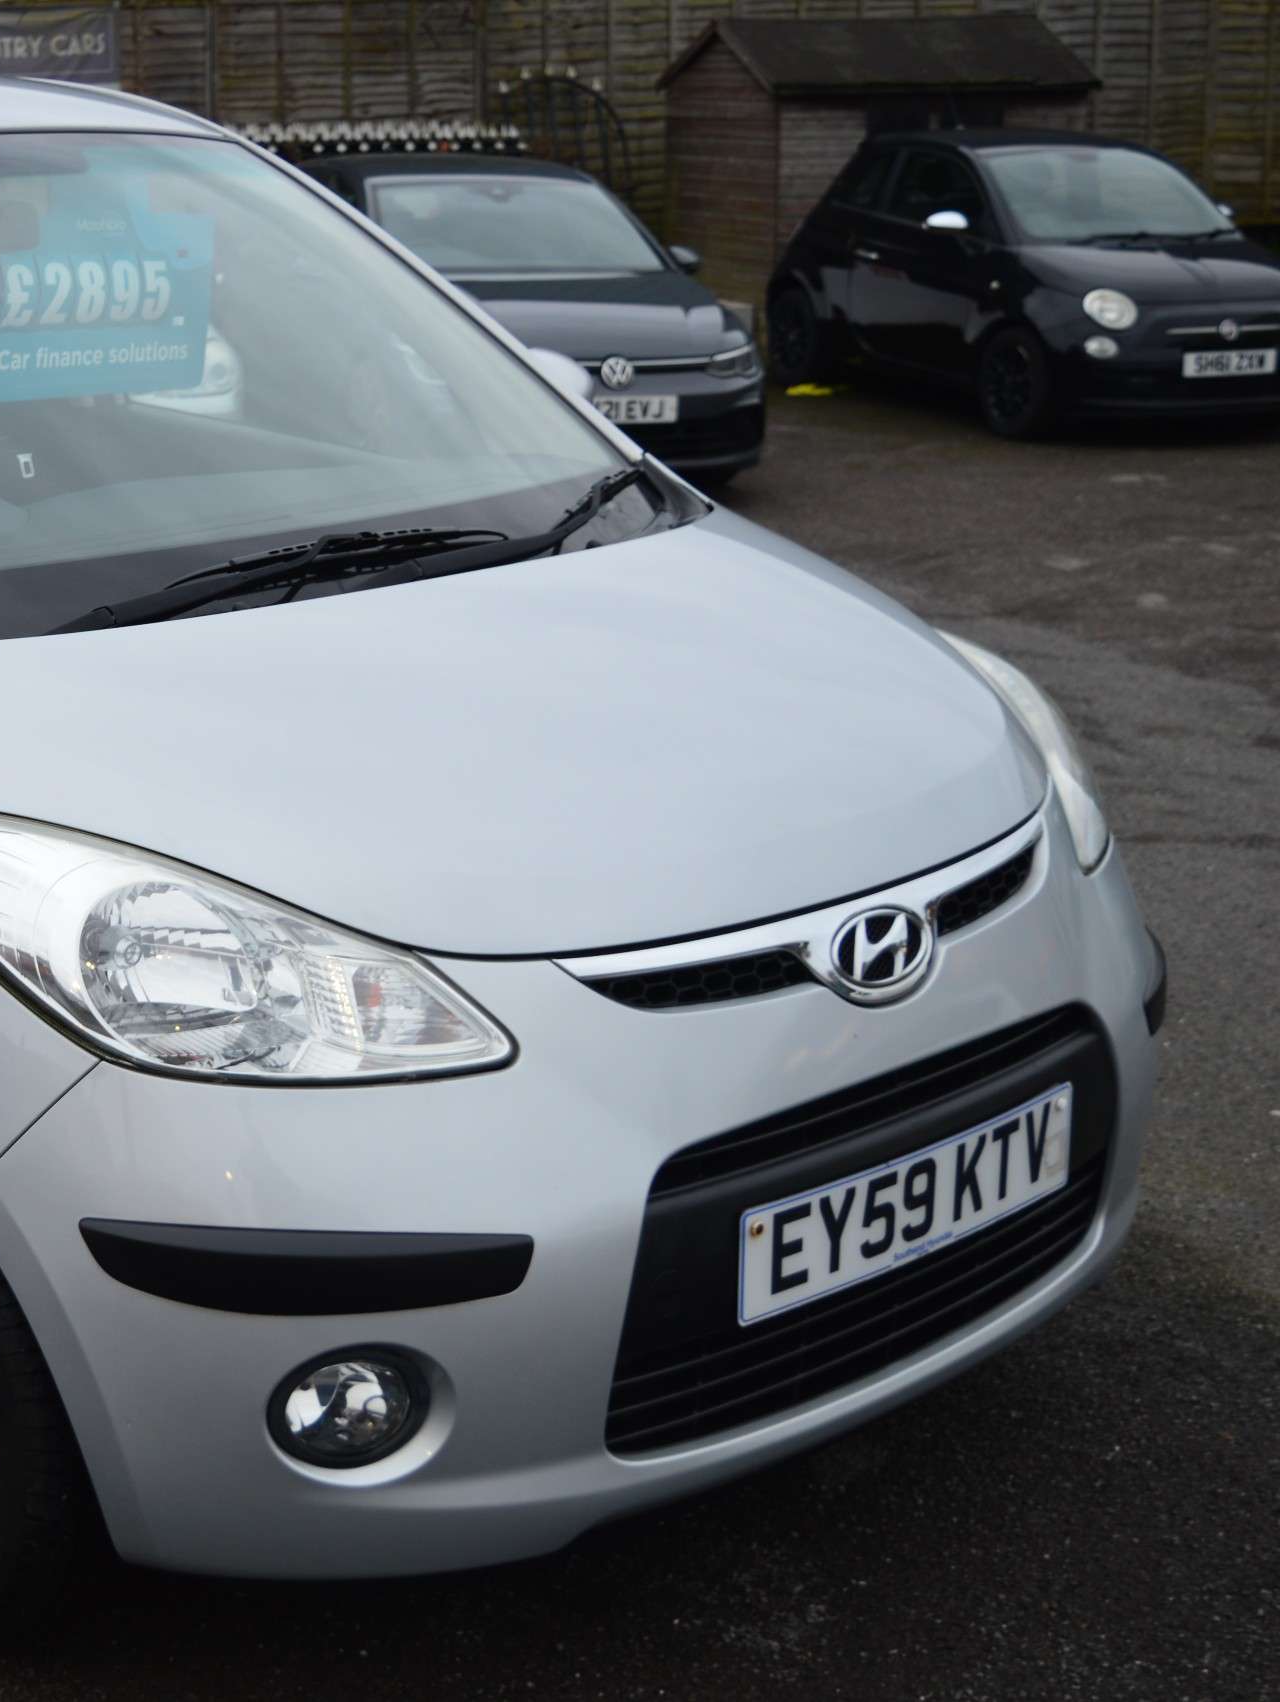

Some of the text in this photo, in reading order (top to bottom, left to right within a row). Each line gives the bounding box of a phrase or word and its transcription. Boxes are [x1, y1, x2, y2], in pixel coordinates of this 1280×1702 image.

[50, 32, 105, 56] CARS
[36, 346, 103, 369] finance
[108, 341, 189, 363] solutions
[625, 400, 665, 419] EVJ
[771, 1101, 1052, 1295] EY59 KTV
